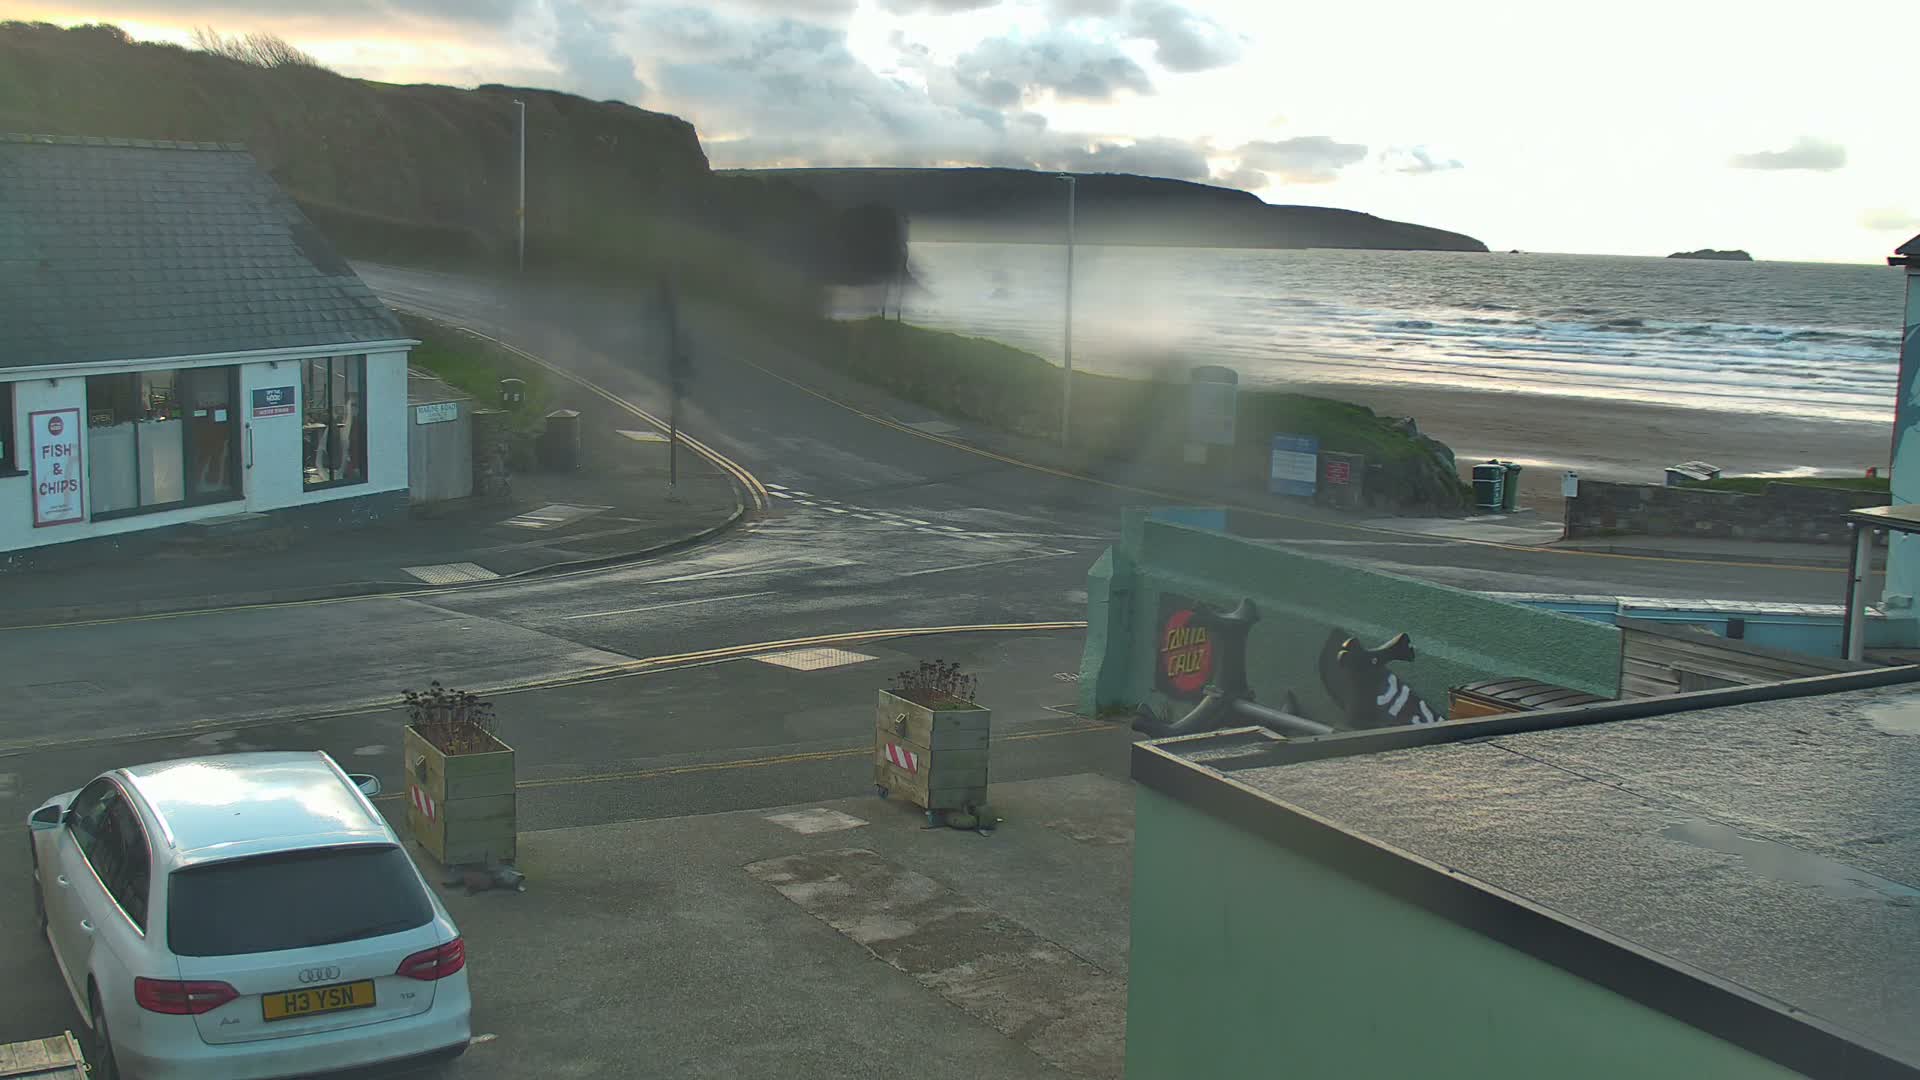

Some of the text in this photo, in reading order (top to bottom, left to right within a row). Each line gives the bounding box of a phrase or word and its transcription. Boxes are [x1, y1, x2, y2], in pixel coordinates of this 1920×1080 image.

[42, 443, 72, 459] FISH
[53, 463, 63, 476] &
[39, 480, 78, 496] CHIPS
[1160, 626, 1206, 652] SANTA
[1167, 649, 1205, 677] CRUZ
[285, 986, 354, 1013] H3 YSN
